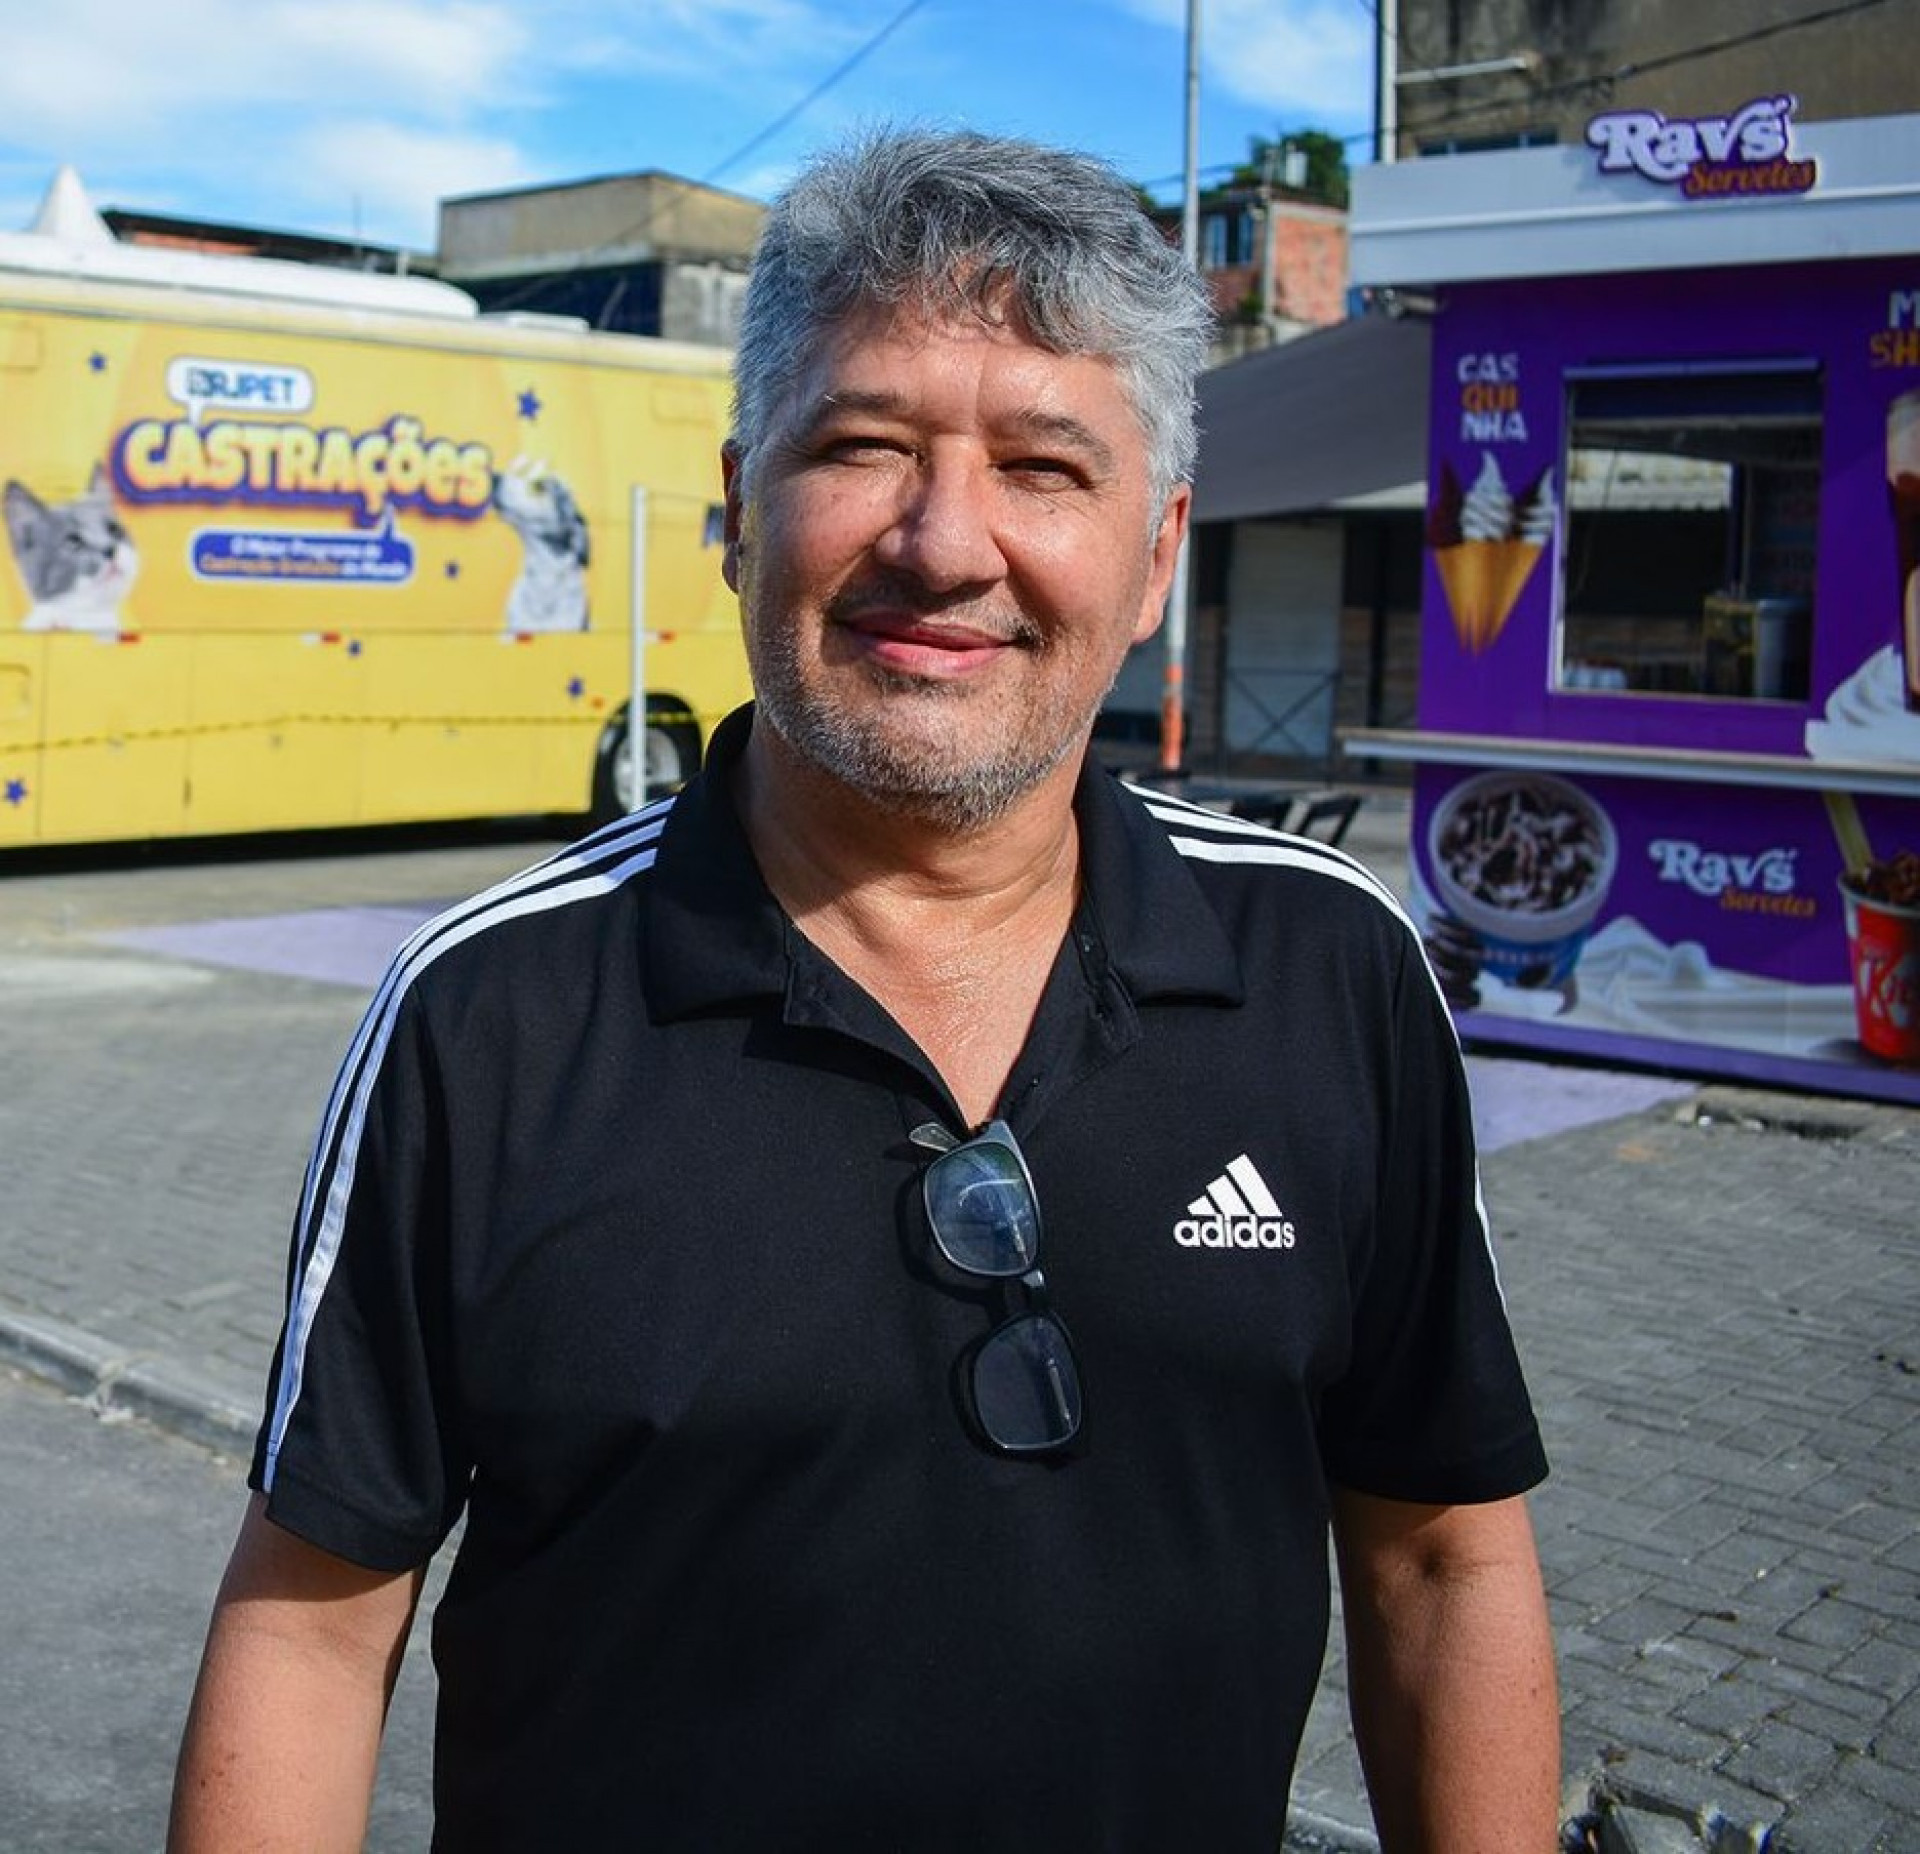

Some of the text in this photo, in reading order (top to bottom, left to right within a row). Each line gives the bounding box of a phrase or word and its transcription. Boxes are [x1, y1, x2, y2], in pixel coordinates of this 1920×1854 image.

[1457, 352, 1519, 382] CAS
[1461, 383, 1518, 413] QUI
[1461, 411, 1528, 442] NHA
[1174, 1214, 1296, 1248] adidas
